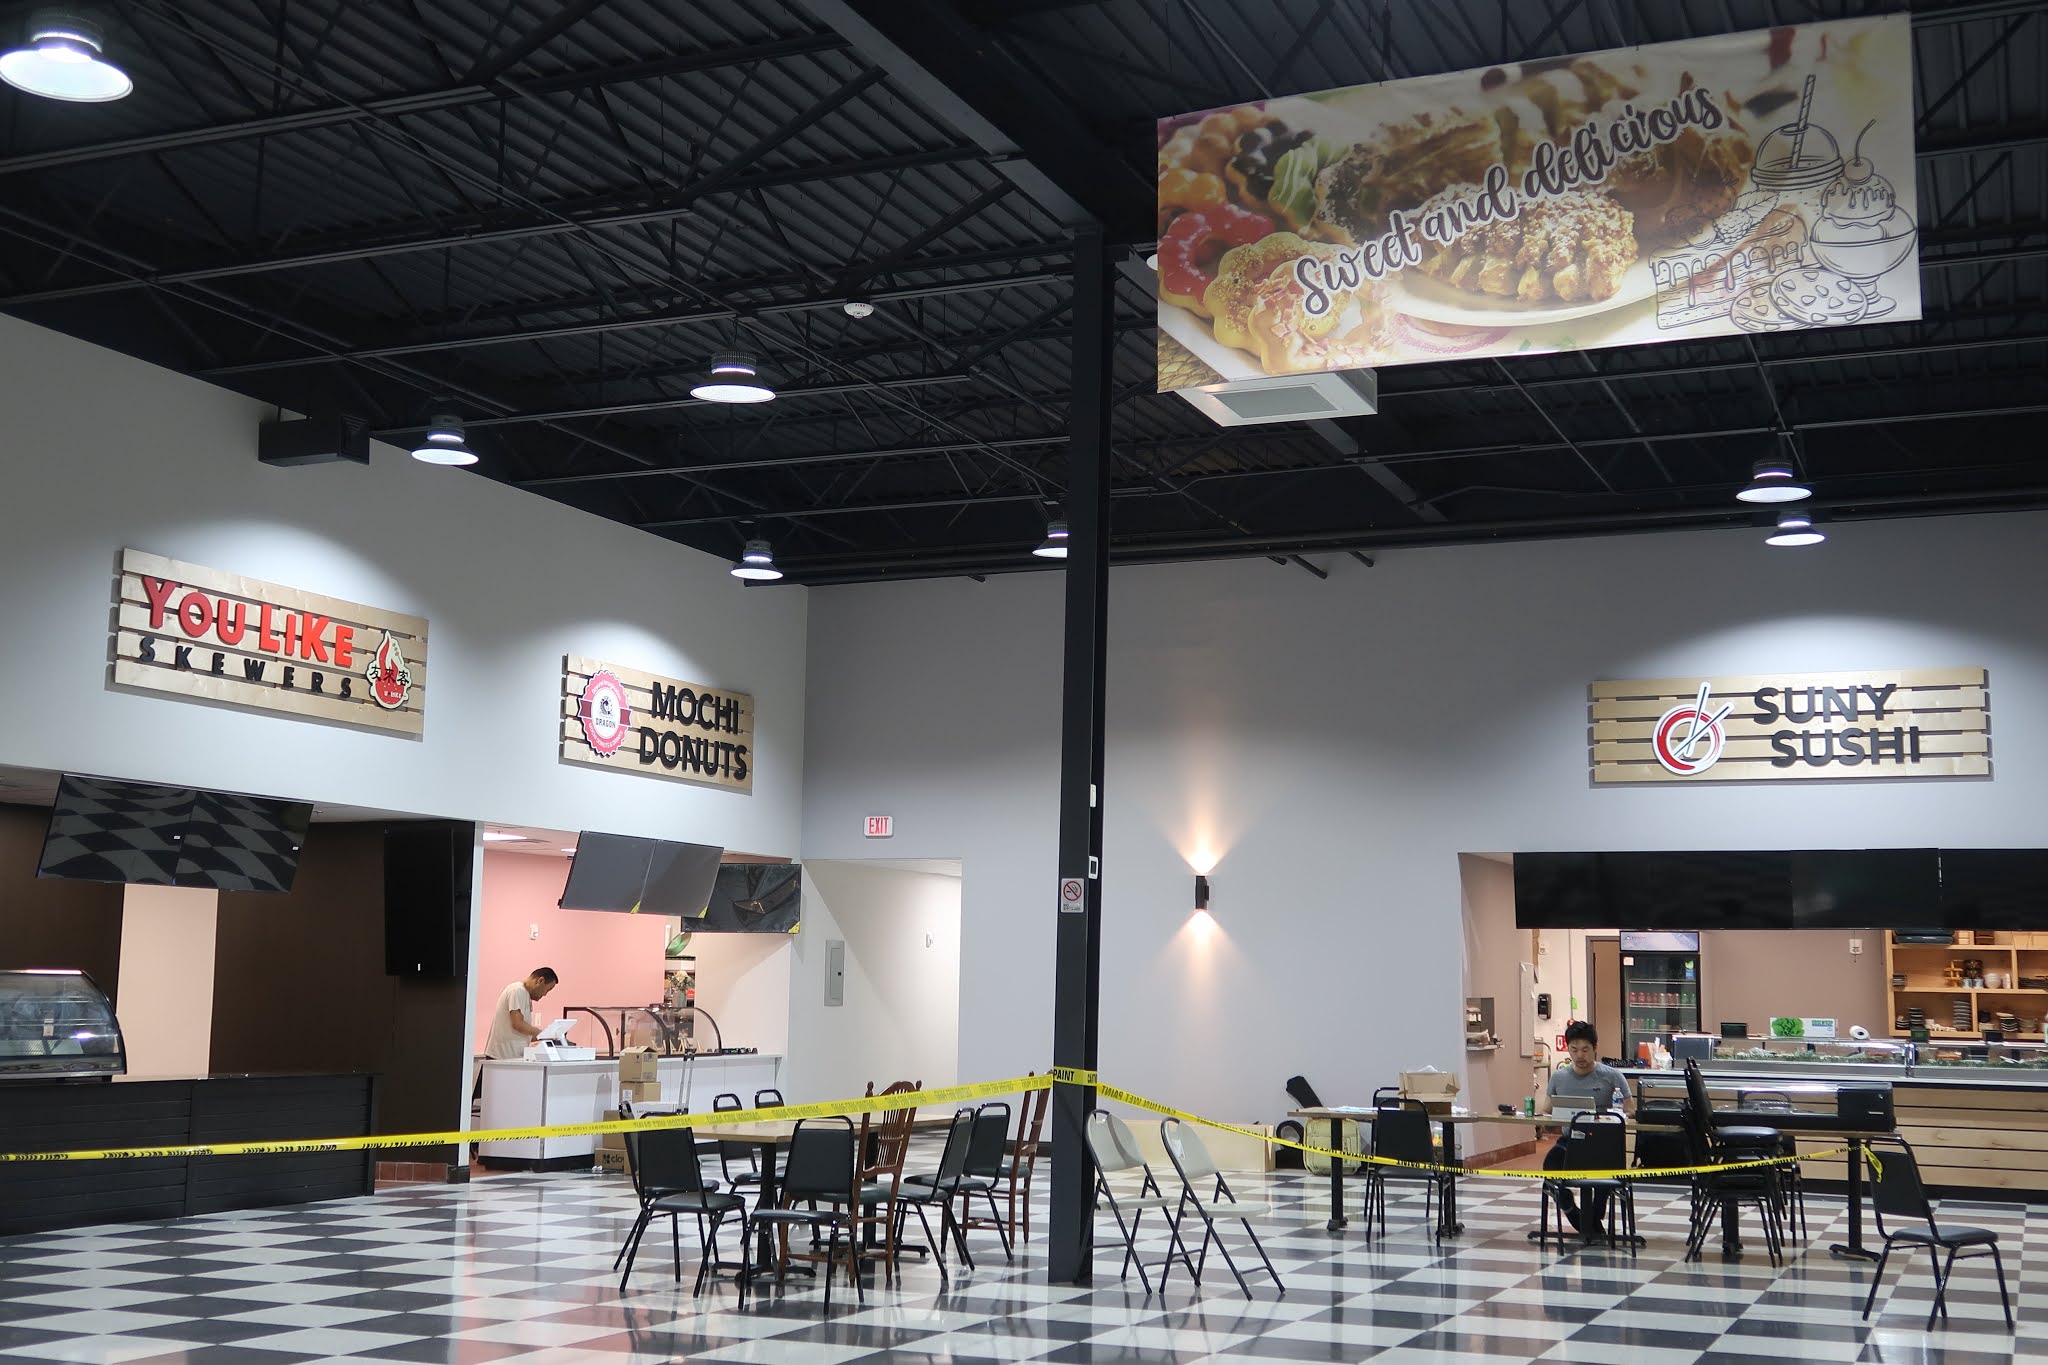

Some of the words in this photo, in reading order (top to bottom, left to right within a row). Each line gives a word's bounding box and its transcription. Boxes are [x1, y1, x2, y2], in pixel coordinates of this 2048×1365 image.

[1297, 212, 1420, 315] Sweet
[1425, 166, 1516, 242] and
[1525, 88, 1723, 198] delicious
[142, 576, 246, 645] YOU
[259, 602, 354, 667] LIKE
[139, 635, 352, 698] SKEWERS
[595, 717, 616, 728] DRAGON
[651, 681, 739, 734] MOCHI
[1753, 683, 1898, 725] SUNY
[639, 726, 748, 780] DONUTS
[1771, 725, 1921, 768] SUSHI
[869, 817, 889, 834] EXIT
[1053, 1069, 1075, 1081] PAINT
[611, 1154, 624, 1163] clo
